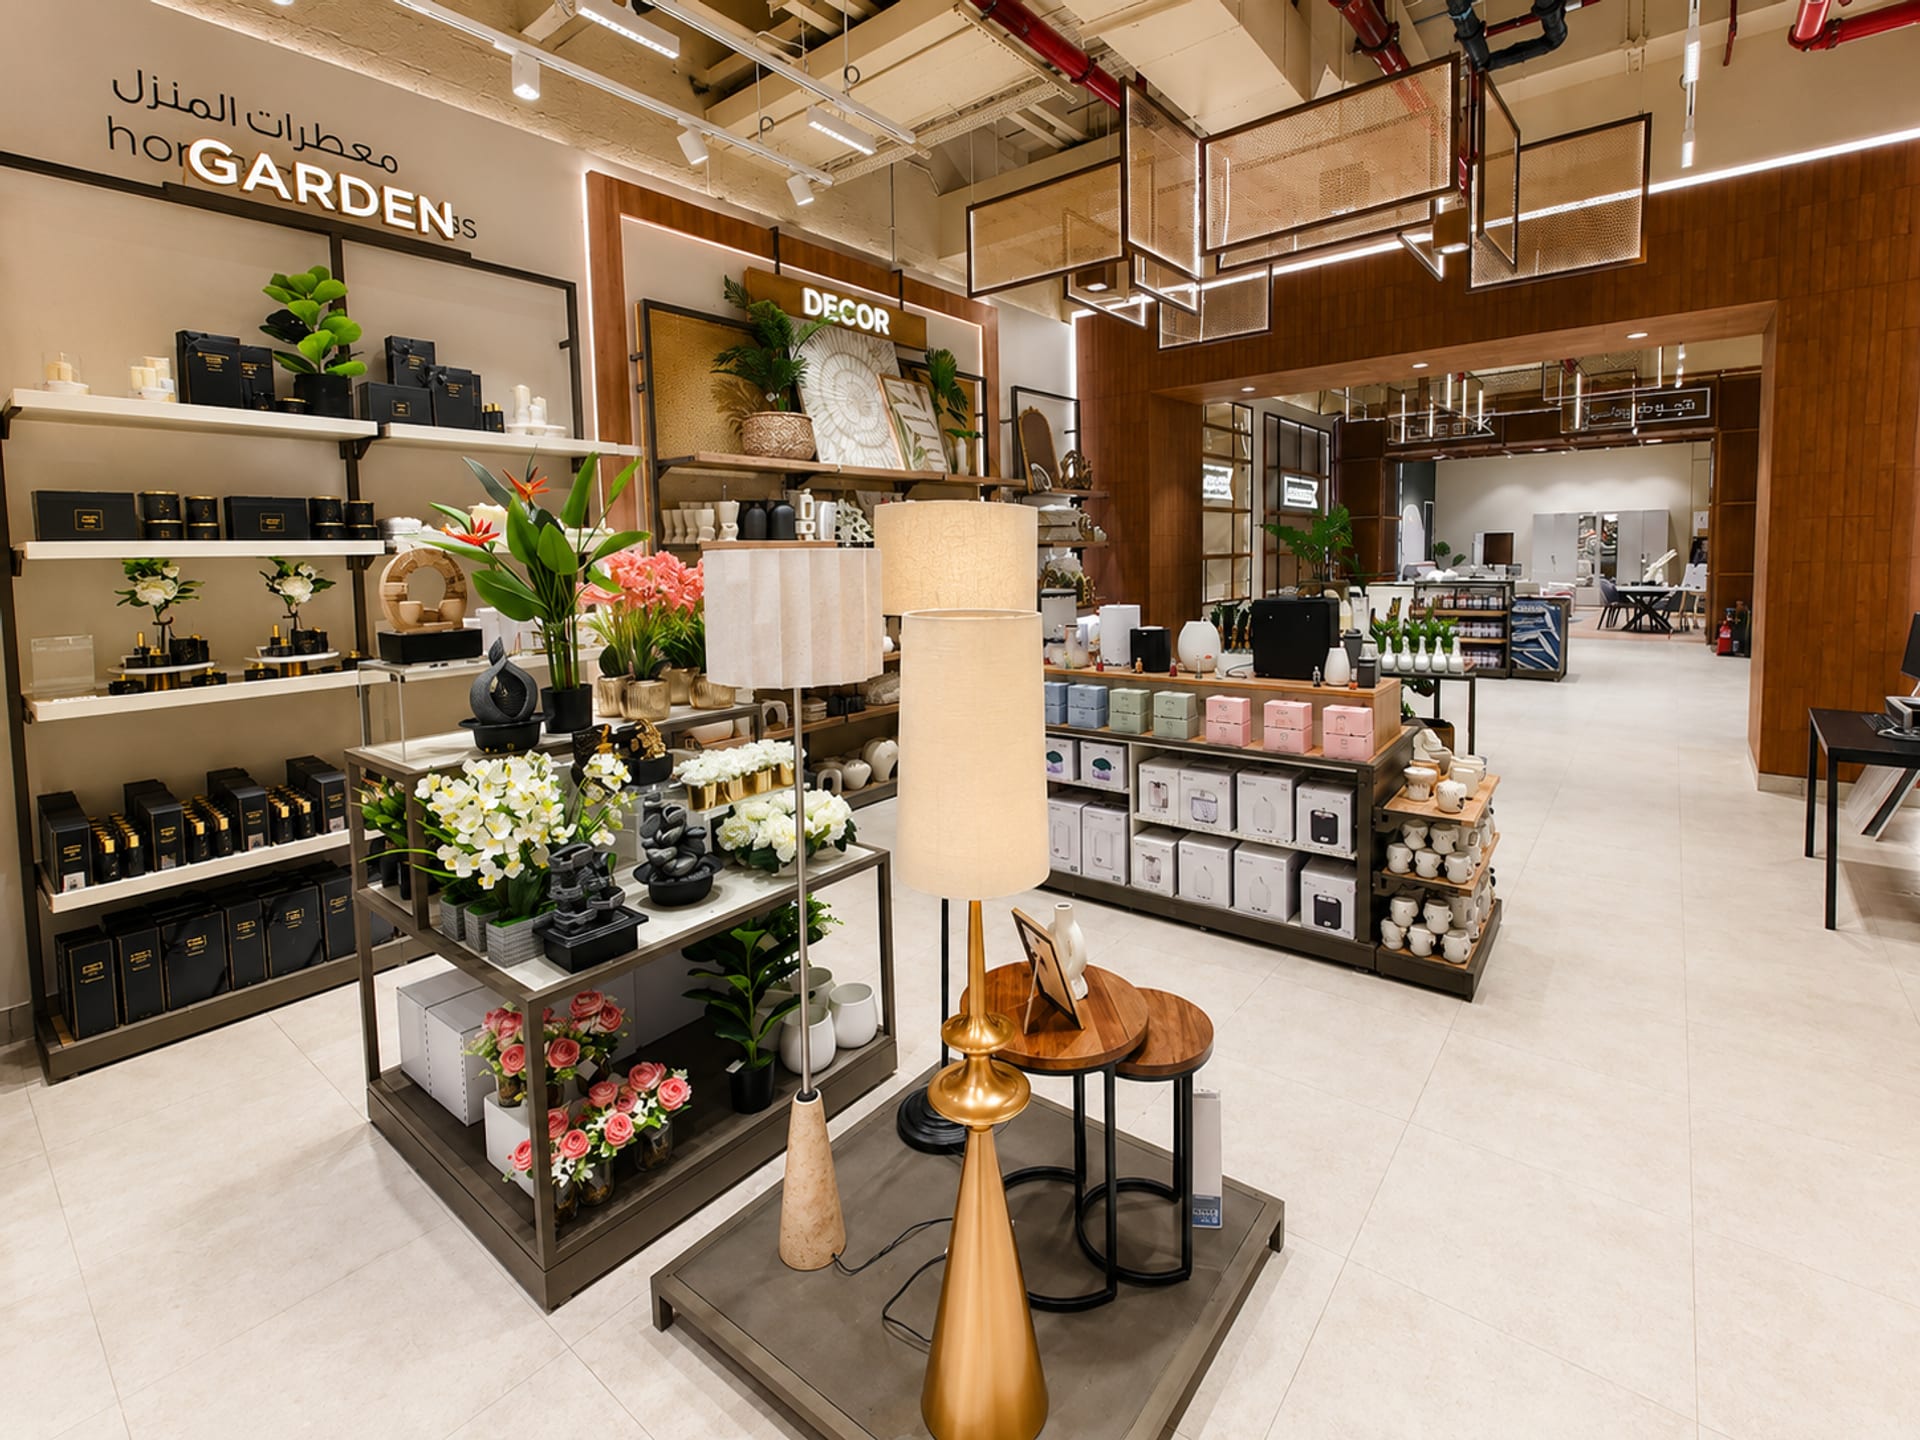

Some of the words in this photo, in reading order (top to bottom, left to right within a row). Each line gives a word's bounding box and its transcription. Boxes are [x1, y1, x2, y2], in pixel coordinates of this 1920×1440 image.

[112, 69, 236, 127] المنزل
[246, 109, 398, 174] معطرات
[187, 138, 455, 240] GARDEN
[802, 287, 891, 336] DECOR
